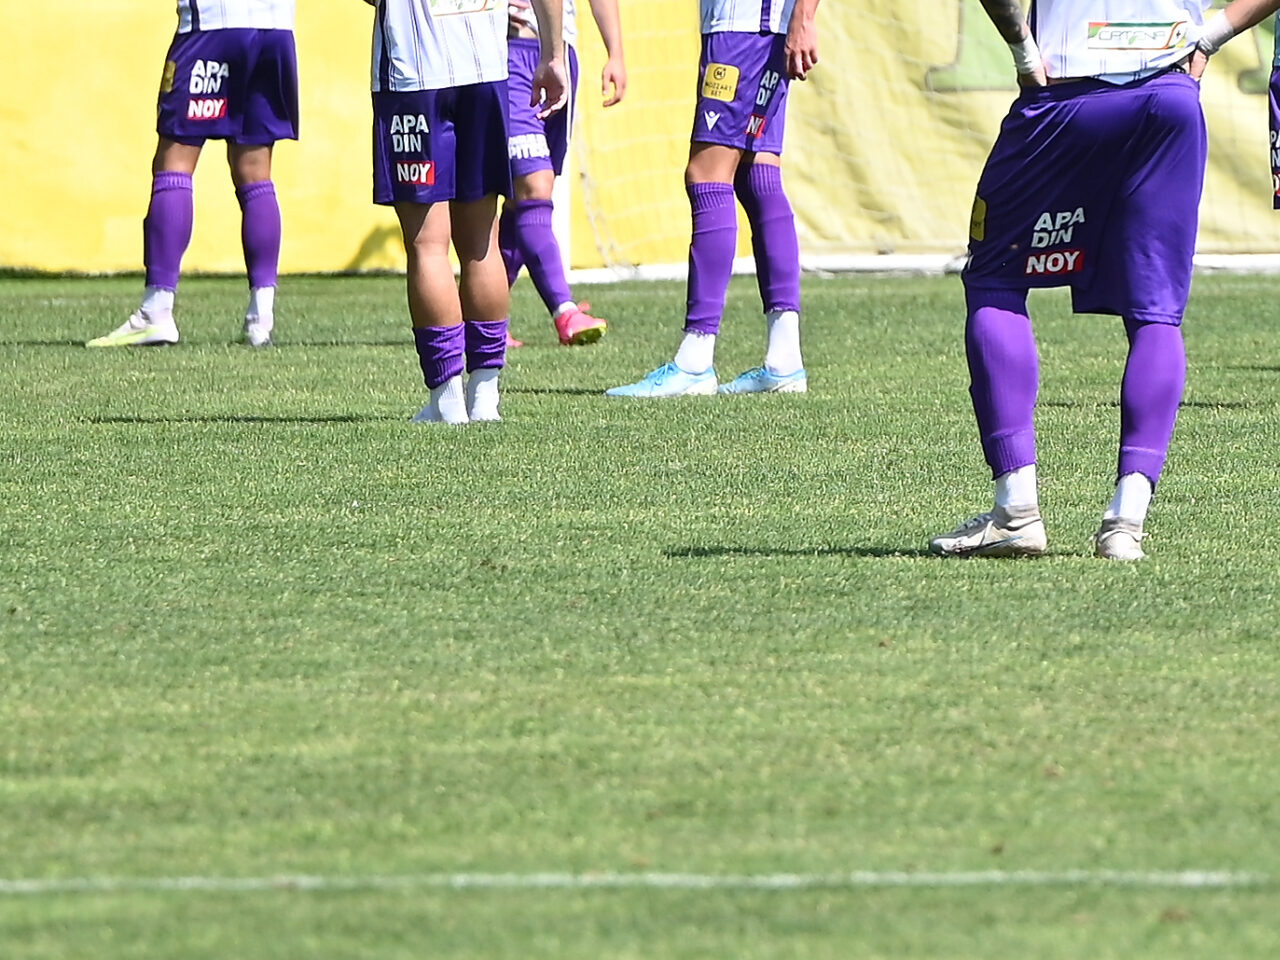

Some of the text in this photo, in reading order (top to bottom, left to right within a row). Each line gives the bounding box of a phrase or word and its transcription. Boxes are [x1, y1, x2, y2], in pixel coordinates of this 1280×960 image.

[191, 59, 229, 78] APA
[189, 75, 221, 94] DIN
[760, 69, 780, 90] AP
[756, 89, 772, 107] DI
[187, 99, 224, 118] NOY
[390, 114, 429, 134] APA
[393, 134, 422, 152] DIN
[397, 163, 431, 183] NOY
[1033, 207, 1086, 231] APA
[1031, 226, 1074, 248] DIN
[1026, 251, 1081, 274] NOY
